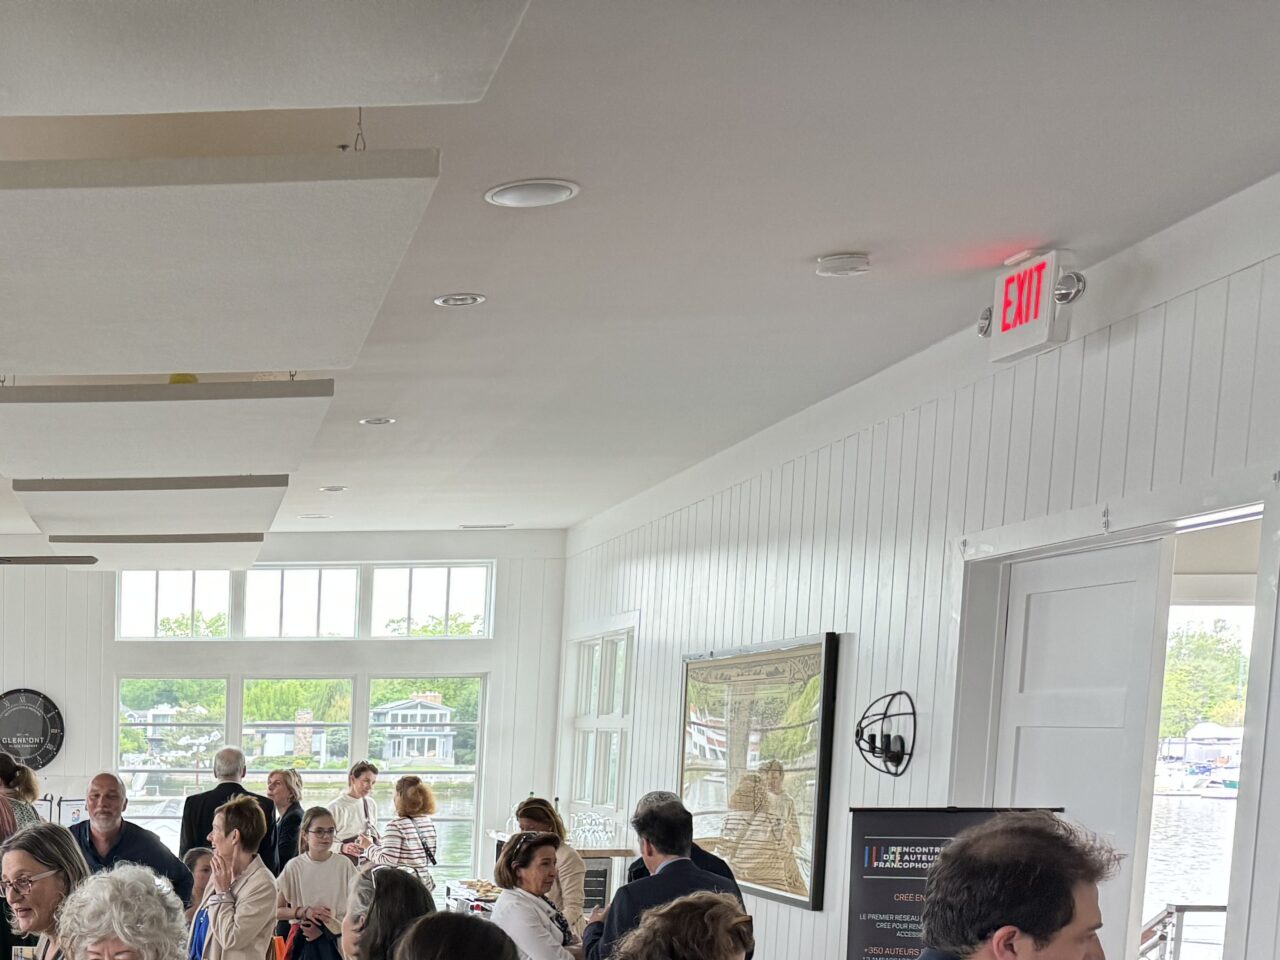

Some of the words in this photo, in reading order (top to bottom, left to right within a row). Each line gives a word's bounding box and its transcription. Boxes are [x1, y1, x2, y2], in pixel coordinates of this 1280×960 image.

[1001, 260, 1047, 333] EXIT
[867, 913, 894, 921] PREMIER
[891, 922, 908, 930] POUR
[884, 947, 920, 956] AUTEURS
